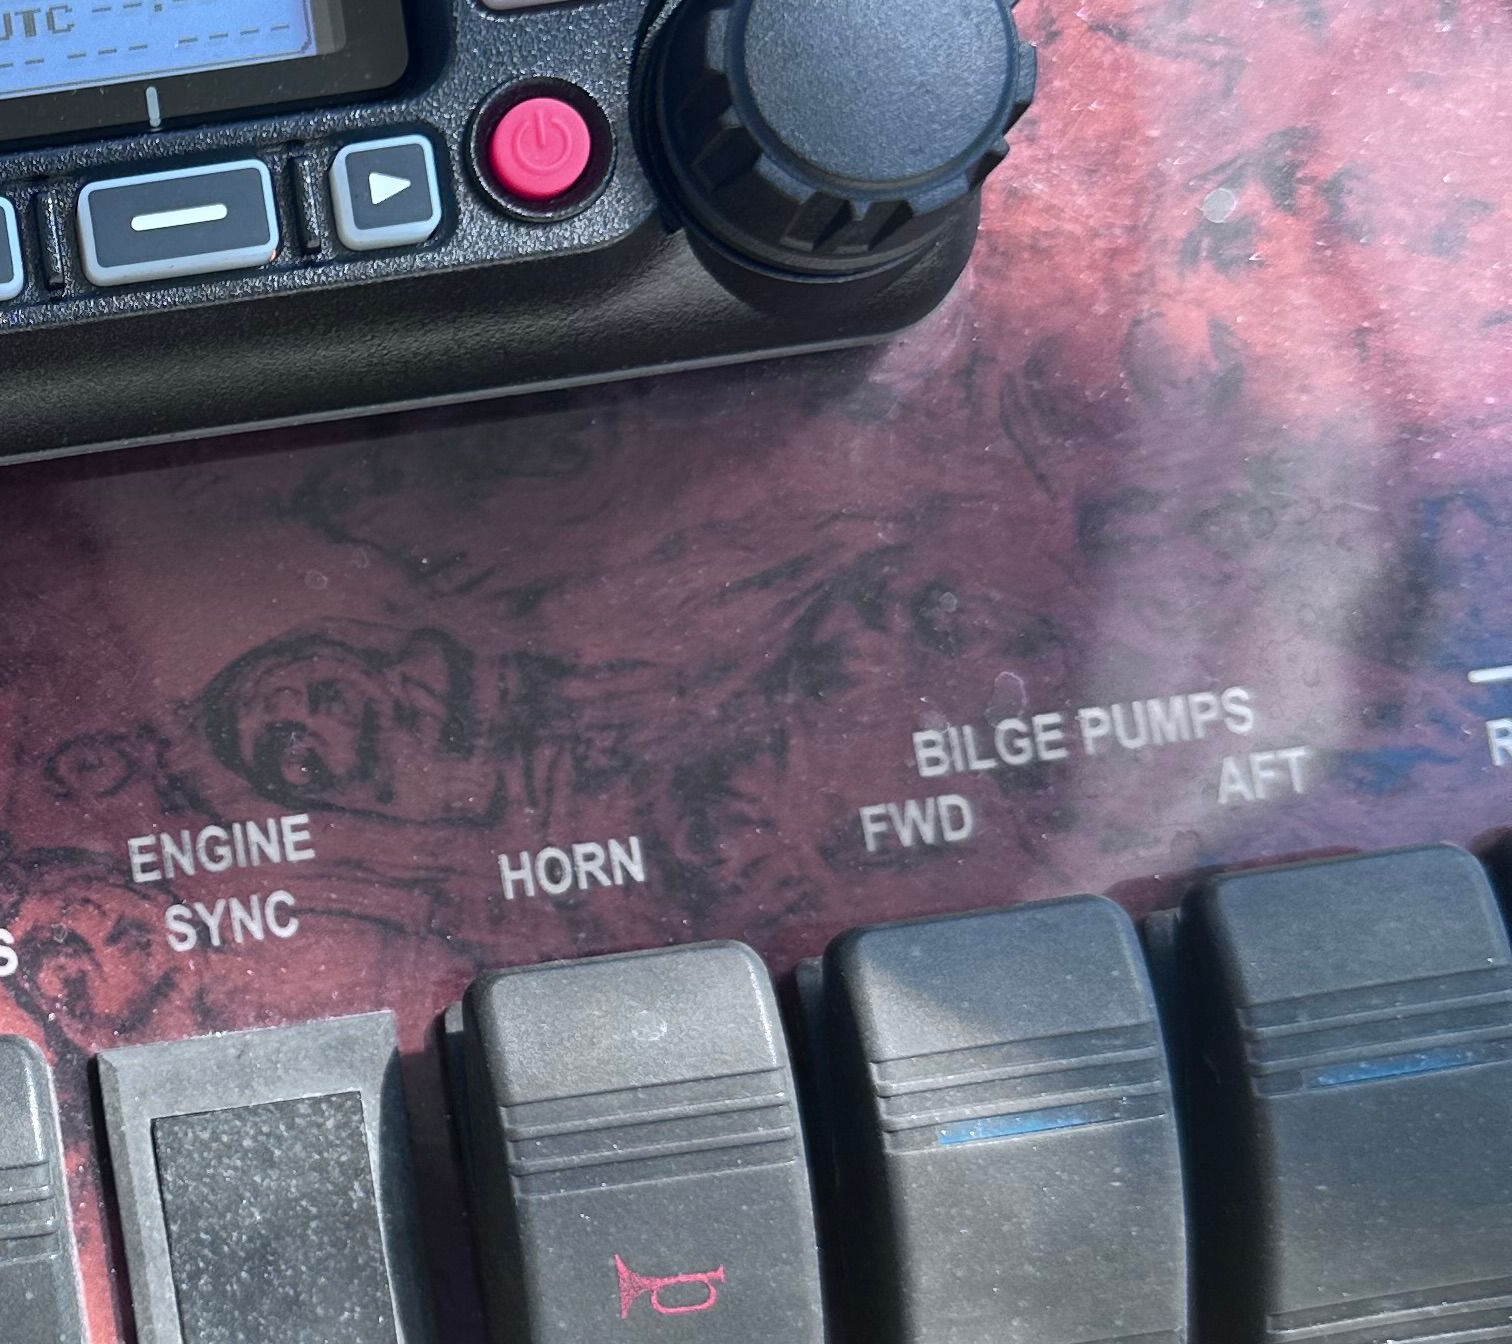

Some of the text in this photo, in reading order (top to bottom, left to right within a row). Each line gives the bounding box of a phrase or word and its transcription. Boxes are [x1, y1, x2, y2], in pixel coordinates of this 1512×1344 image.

[913, 686, 1255, 777] BILGE PUMPS
[1217, 745, 1312, 804] AFT
[126, 812, 317, 884] ENGINE
[859, 793, 973, 853] FWD
[498, 835, 646, 901] HORN
[164, 889, 301, 954] SYNC
